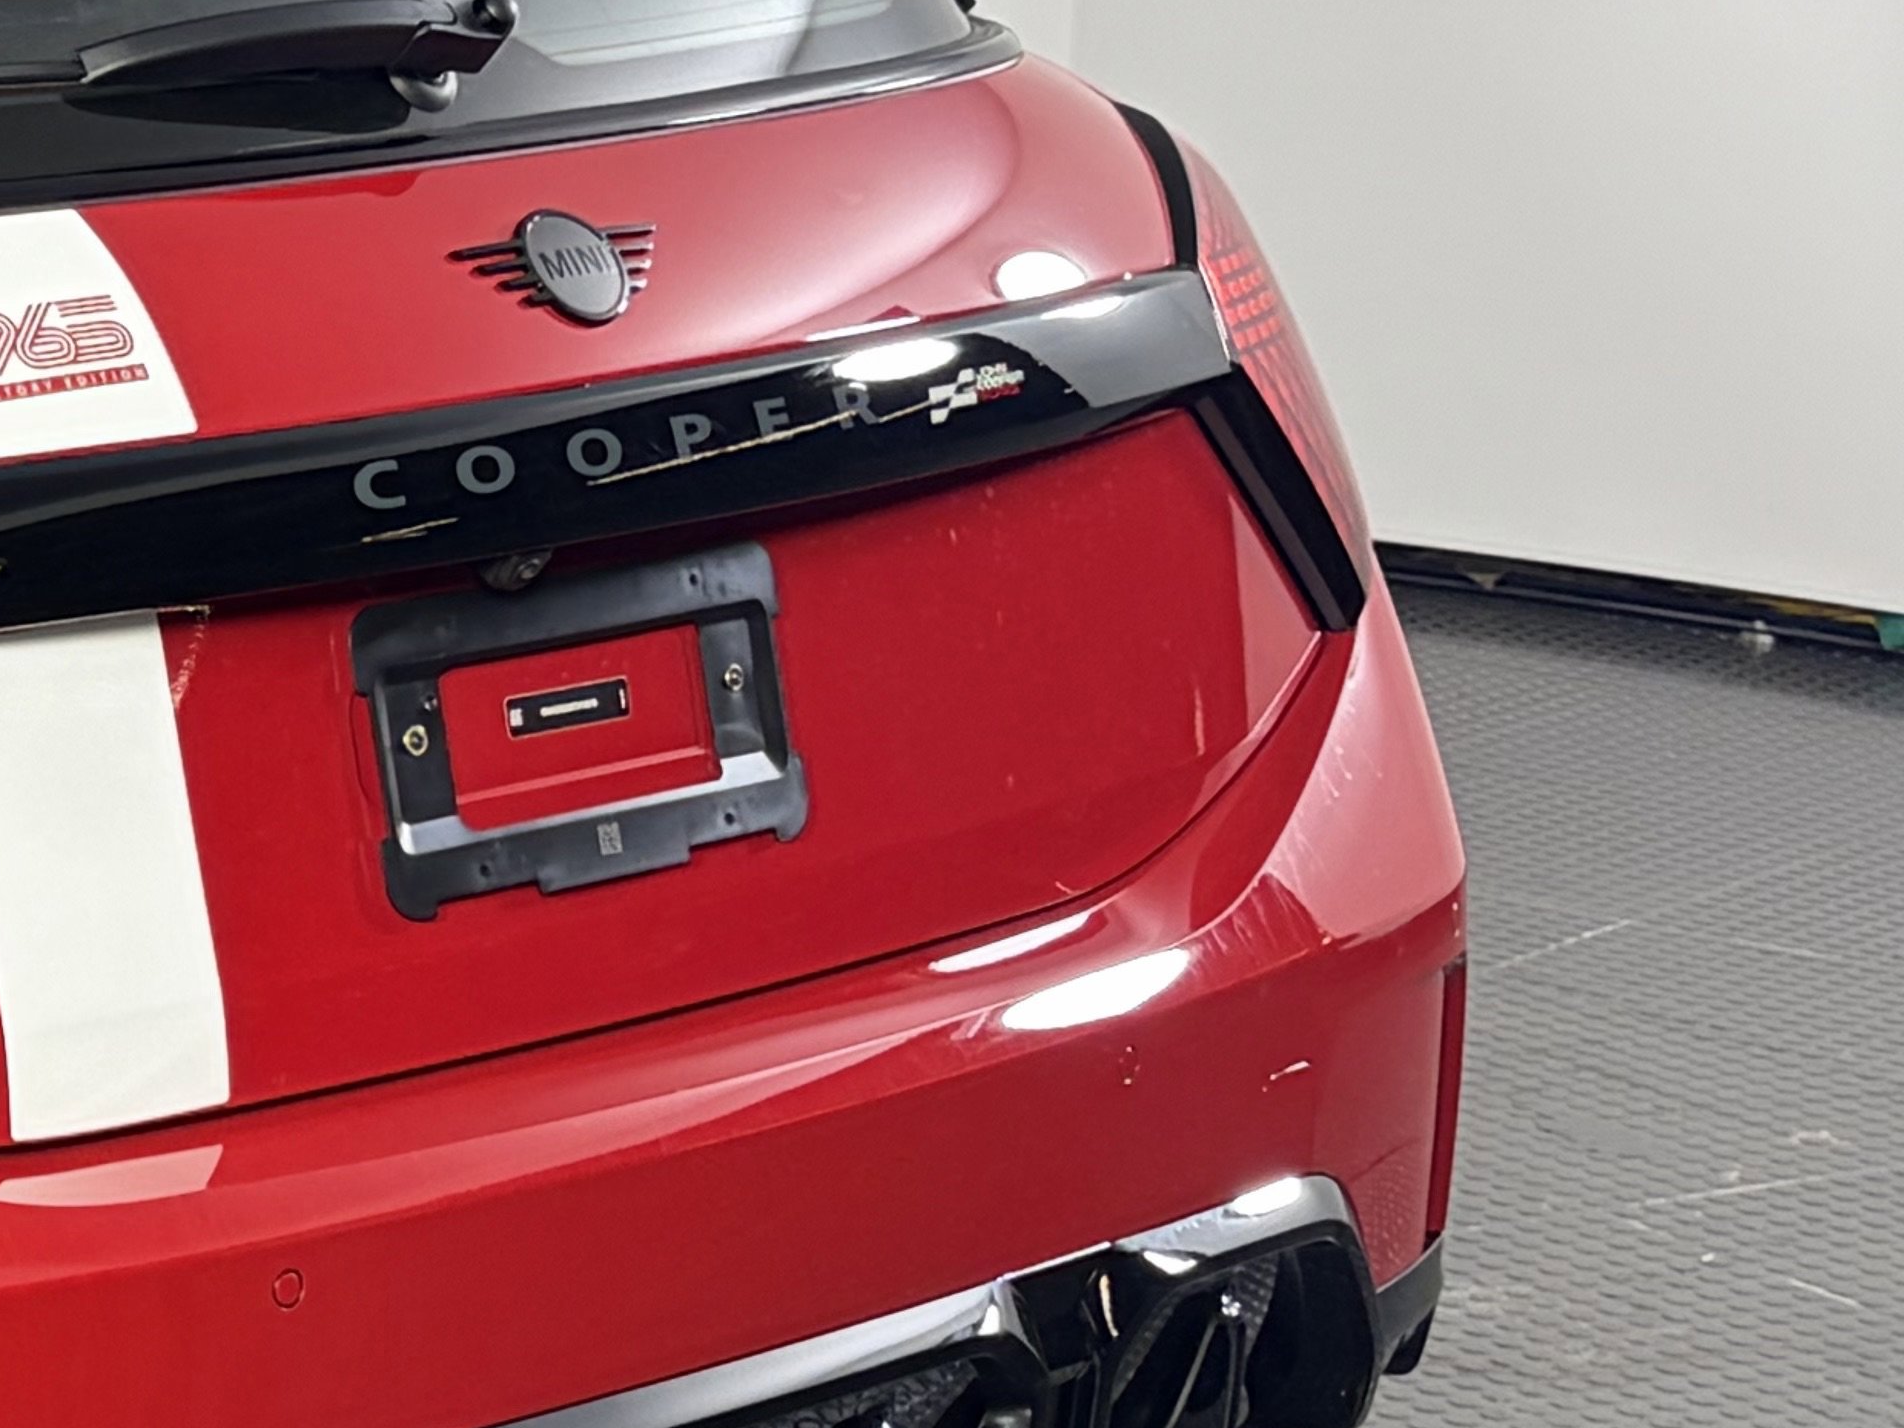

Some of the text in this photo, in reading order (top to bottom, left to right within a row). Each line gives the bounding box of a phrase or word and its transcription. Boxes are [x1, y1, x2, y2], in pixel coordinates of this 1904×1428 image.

[538, 244, 611, 281] MINI
[63, 367, 148, 391] EDITION
[353, 381, 881, 510] COOPER
